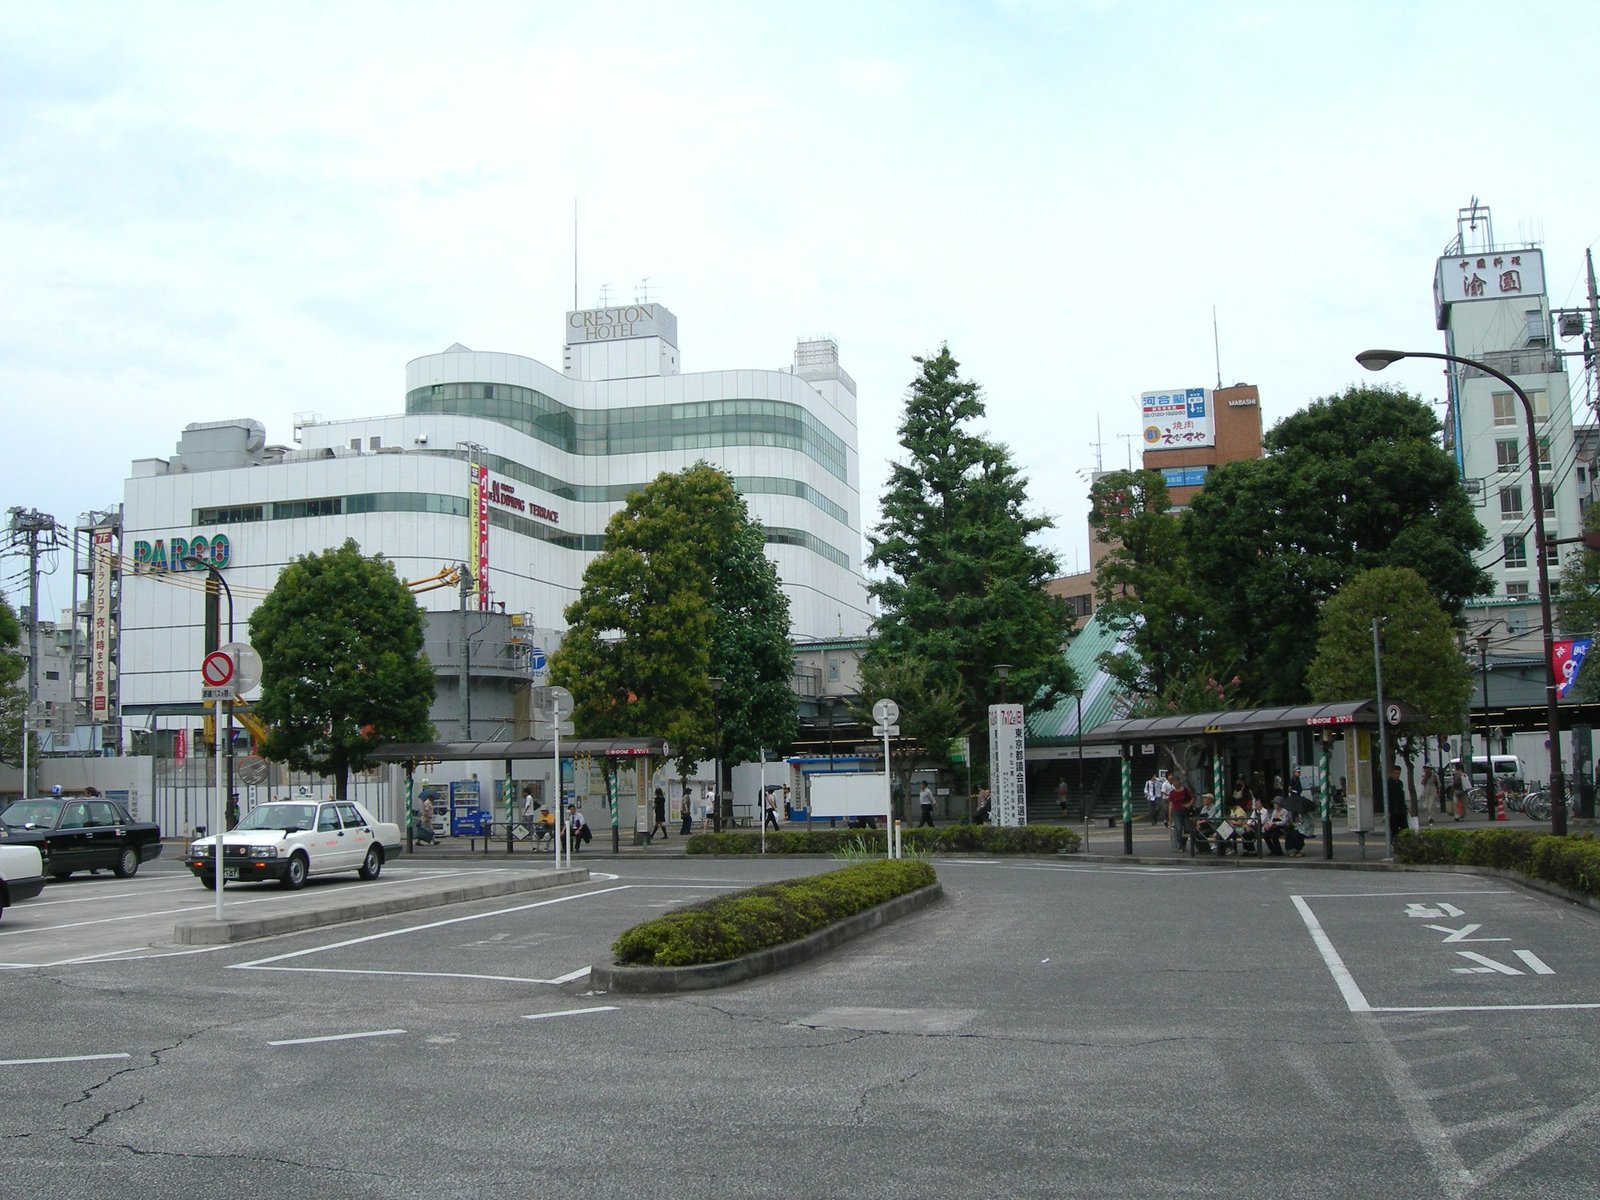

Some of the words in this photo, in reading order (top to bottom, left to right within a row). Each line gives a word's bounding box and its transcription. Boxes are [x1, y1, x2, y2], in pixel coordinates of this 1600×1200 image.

[570, 305, 654, 328] CRESTON
[585, 323, 638, 340] HOTEL
[1143, 394, 1185, 406] 河合塾
[1172, 421, 1194, 430] 焼肉
[1161, 428, 1206, 444] えびすや
[529, 503, 559, 523] TERRACE
[98, 534, 109, 543] 7F
[134, 533, 230, 573] PARCO
[95, 617, 105, 692] 夜11時まで営業
[1390, 708, 1398, 721] 2
[1015, 728, 1025, 826] 東京都議会議員選挙
